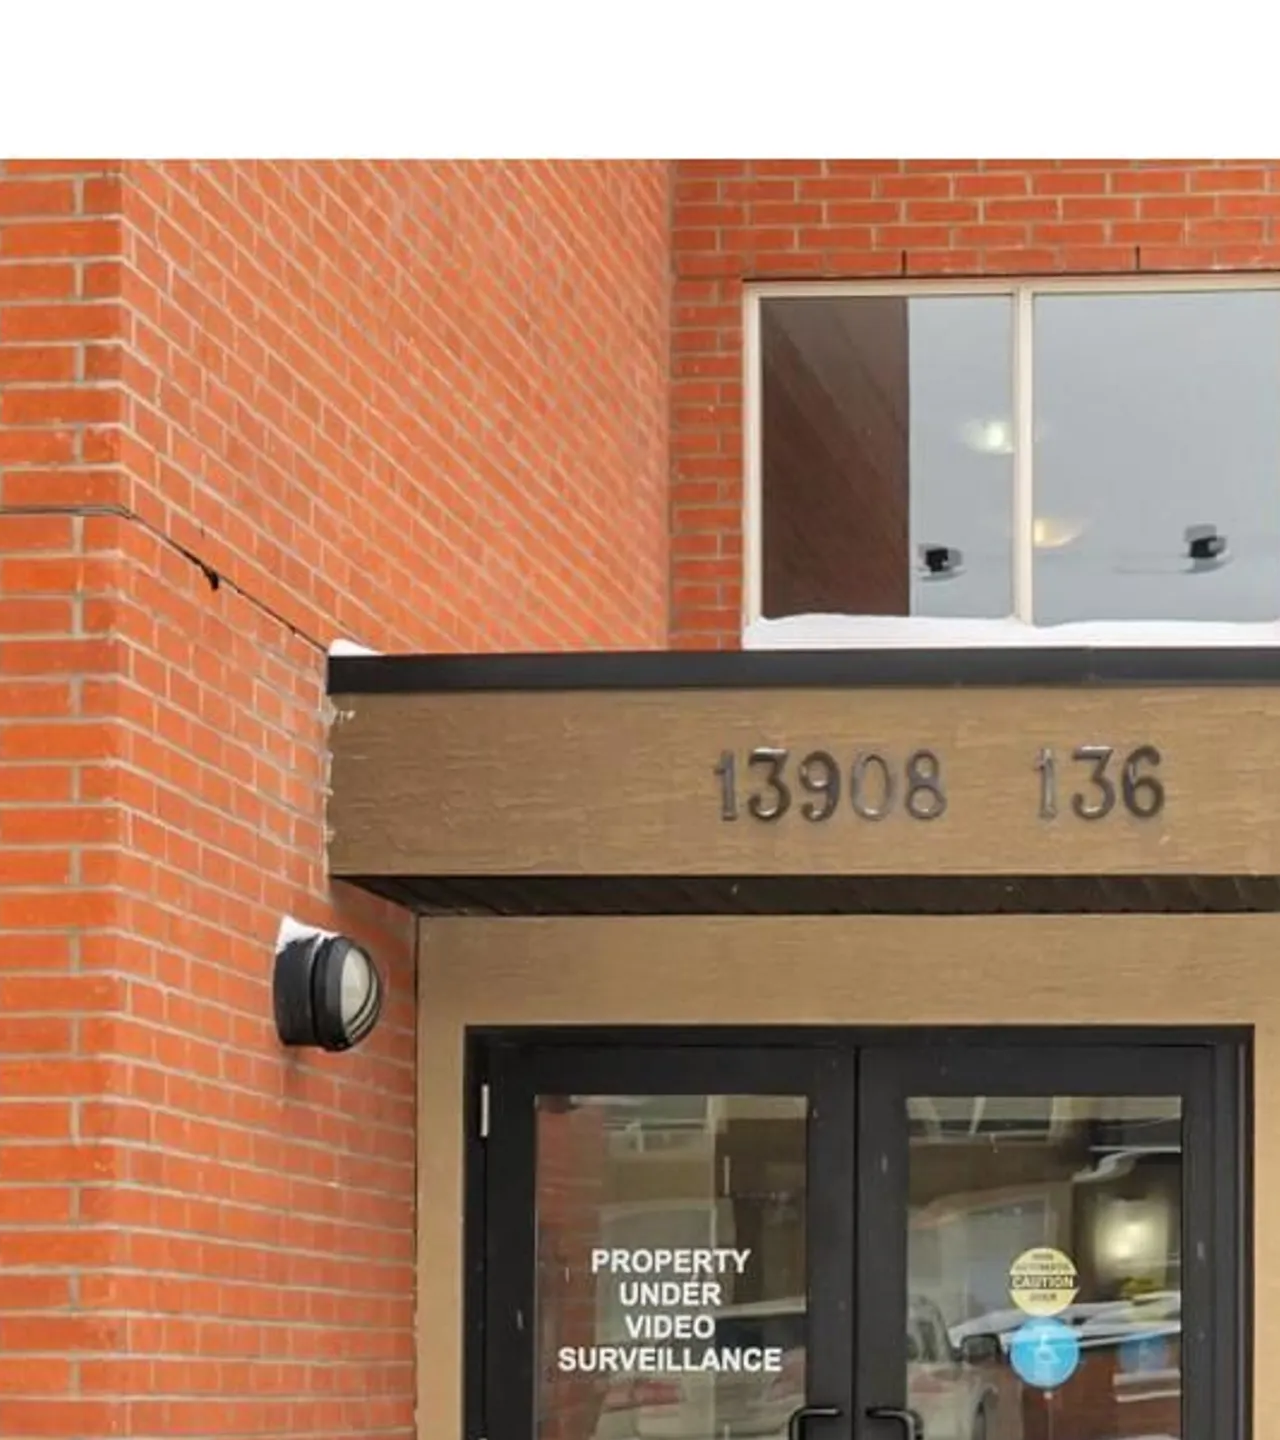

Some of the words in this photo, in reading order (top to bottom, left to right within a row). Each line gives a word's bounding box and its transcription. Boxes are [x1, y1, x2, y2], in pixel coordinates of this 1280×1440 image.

[713, 746, 947, 823] 13908
[1033, 744, 1166, 821] 136
[591, 1249, 752, 1274] PROPERTY
[619, 1281, 722, 1306] UNDER
[1011, 1275, 1074, 1289] CAUTION
[624, 1314, 716, 1339] VIDEO
[557, 1347, 783, 1372] SURVEILLANCE
